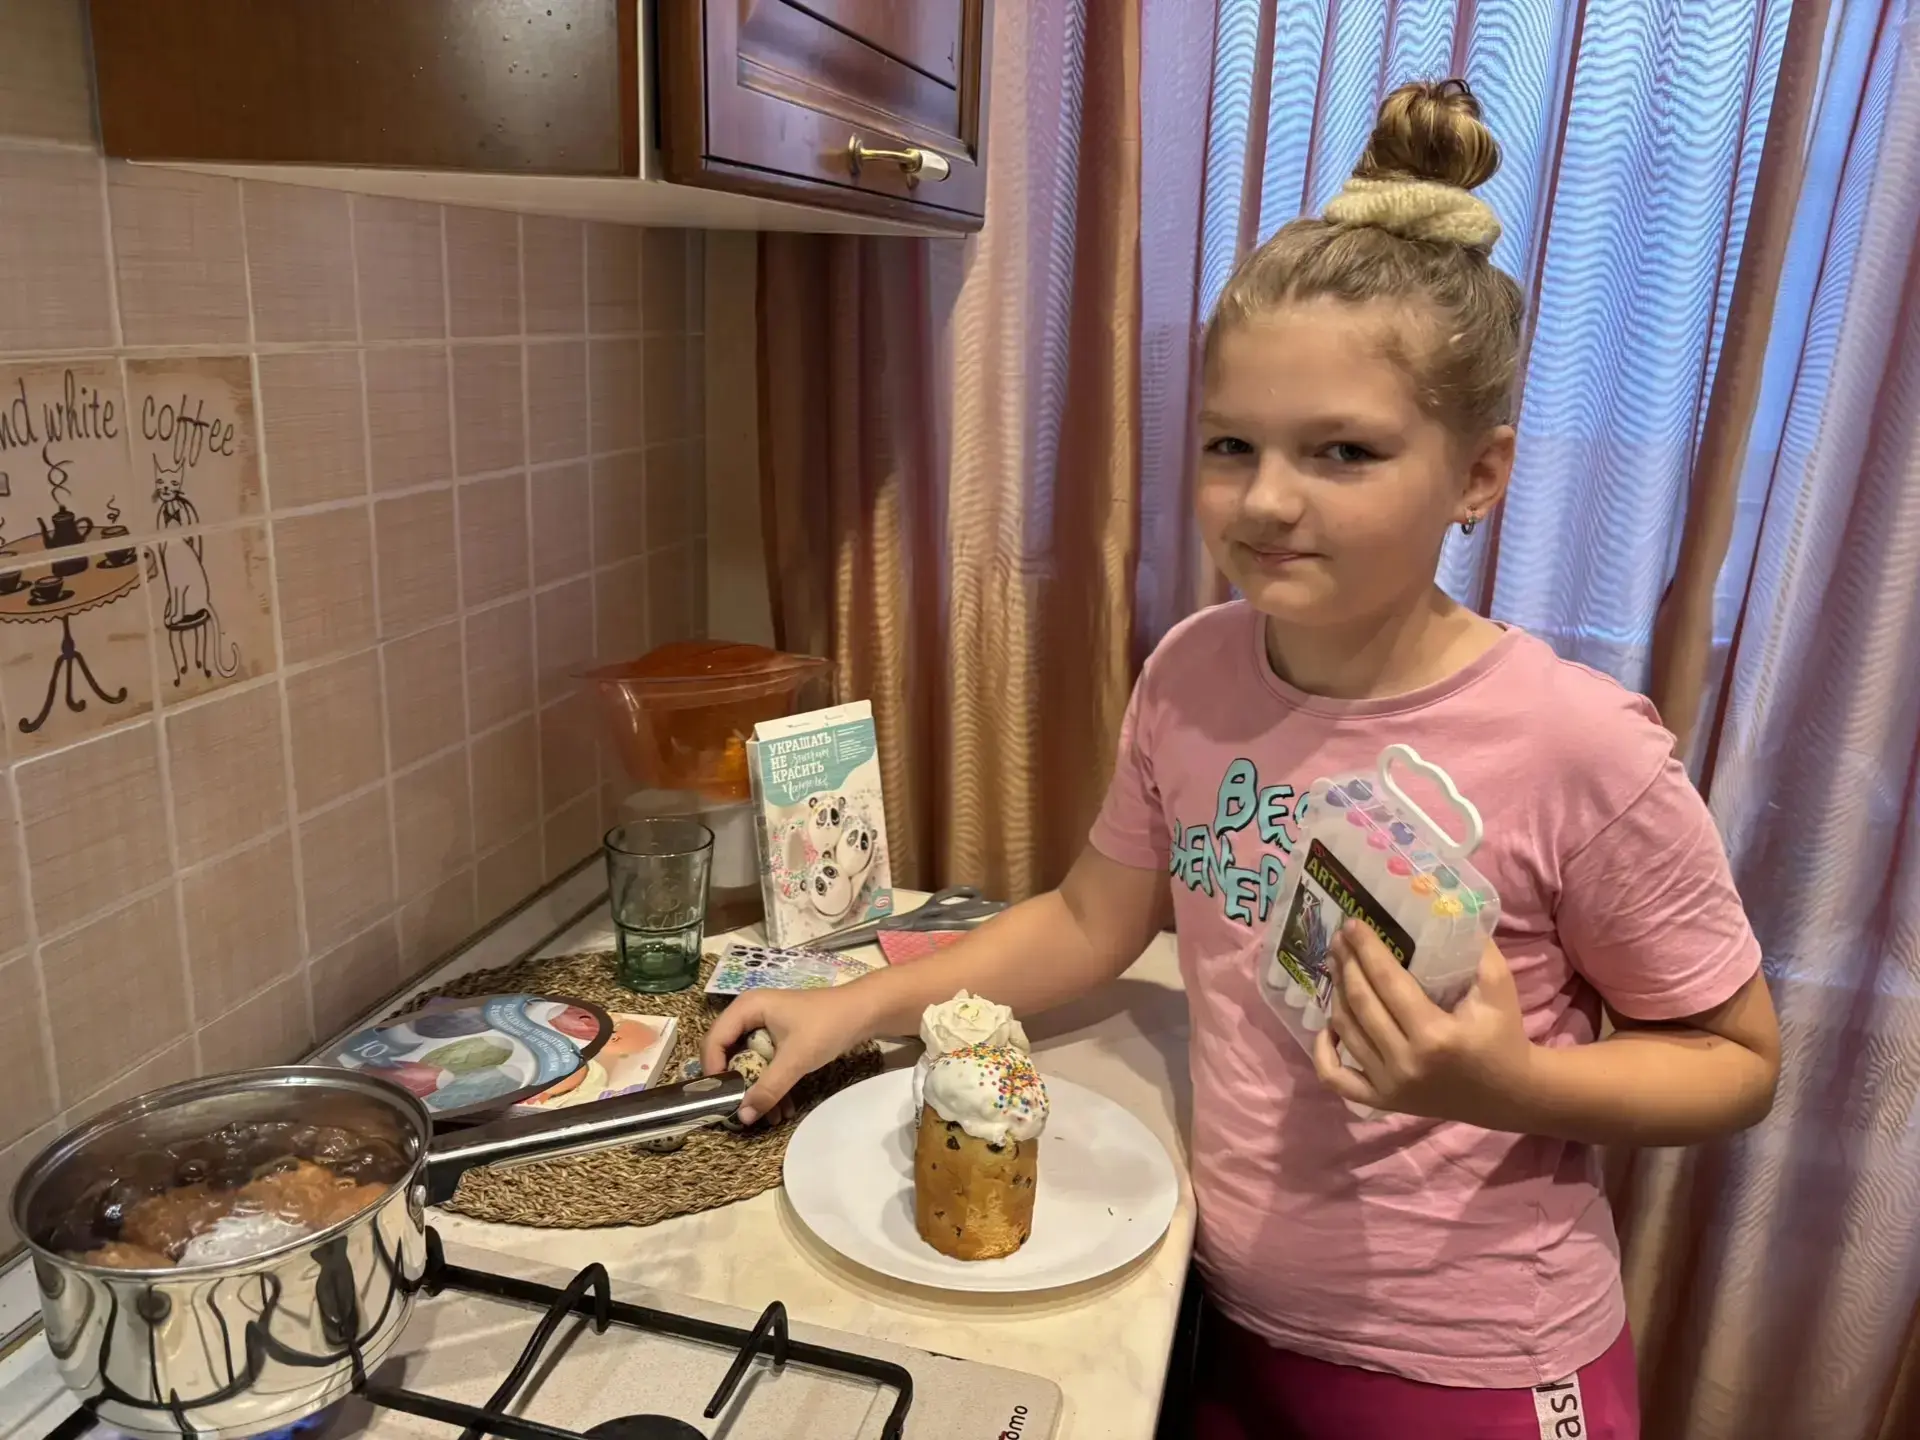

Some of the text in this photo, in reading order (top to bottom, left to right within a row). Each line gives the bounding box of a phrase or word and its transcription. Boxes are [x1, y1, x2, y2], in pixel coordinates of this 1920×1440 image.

[43, 368, 119, 443] white
[142, 394, 234, 467] coffee
[768, 732, 832, 757] УКРАШАТЬ
[771, 755, 788, 770] НЕ
[772, 760, 825, 784] КРАСИТЬ
[352, 1040, 389, 1058] 10
[998, 1405, 1029, 1440] omo
